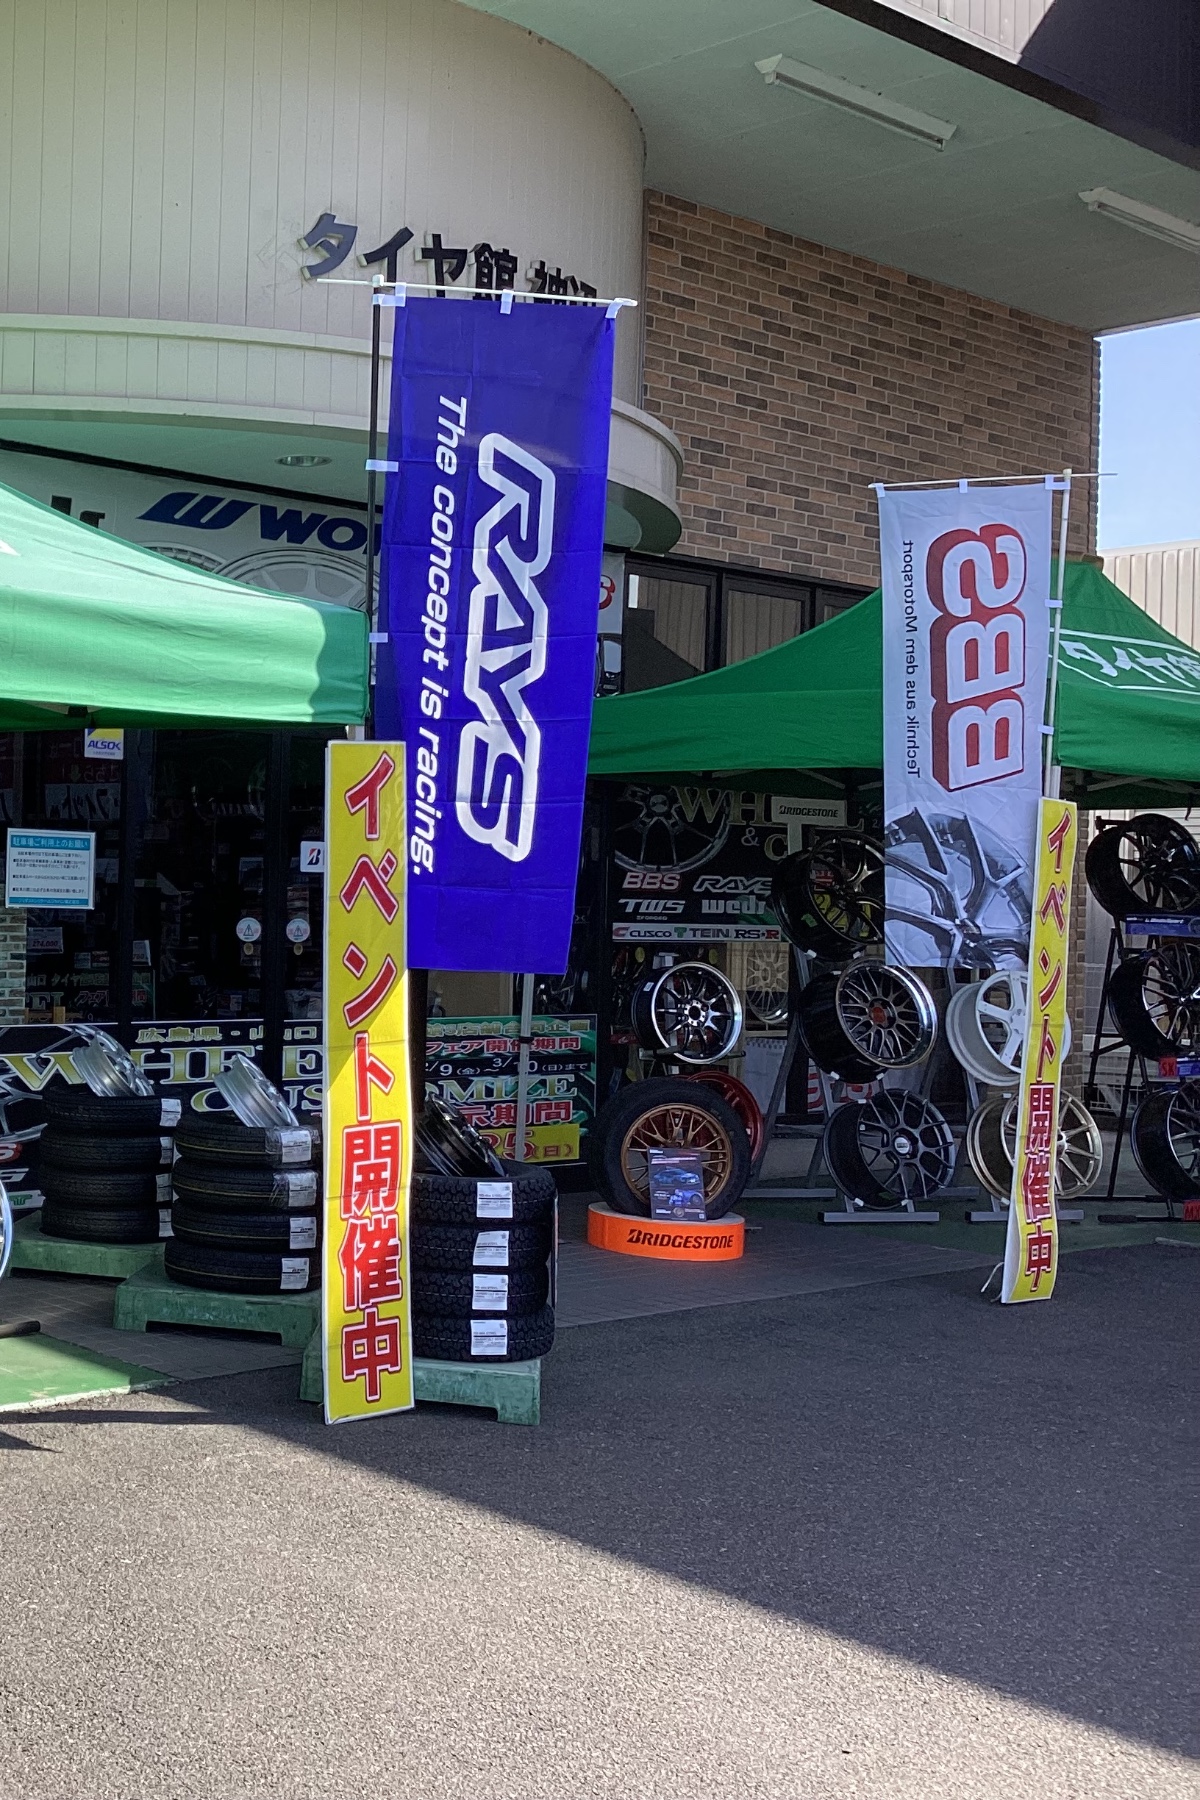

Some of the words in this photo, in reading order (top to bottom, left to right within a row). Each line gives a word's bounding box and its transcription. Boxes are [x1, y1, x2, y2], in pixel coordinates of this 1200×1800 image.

[297, 211, 519, 301] タイヤ館
[436, 395, 467, 475] The
[421, 485, 455, 671] concept
[455, 432, 556, 862] RAYS
[420, 677, 449, 719] is
[87, 740, 121, 751] ALSOK
[410, 727, 442, 875] racing.
[779, 805, 839, 818] BRIDGESTONE
[618, 898, 686, 914] TWS
[621, 872, 681, 892] BBS
[340, 751, 402, 1402] イベント開催中
[627, 1229, 735, 1249] BRIDGESTONE
